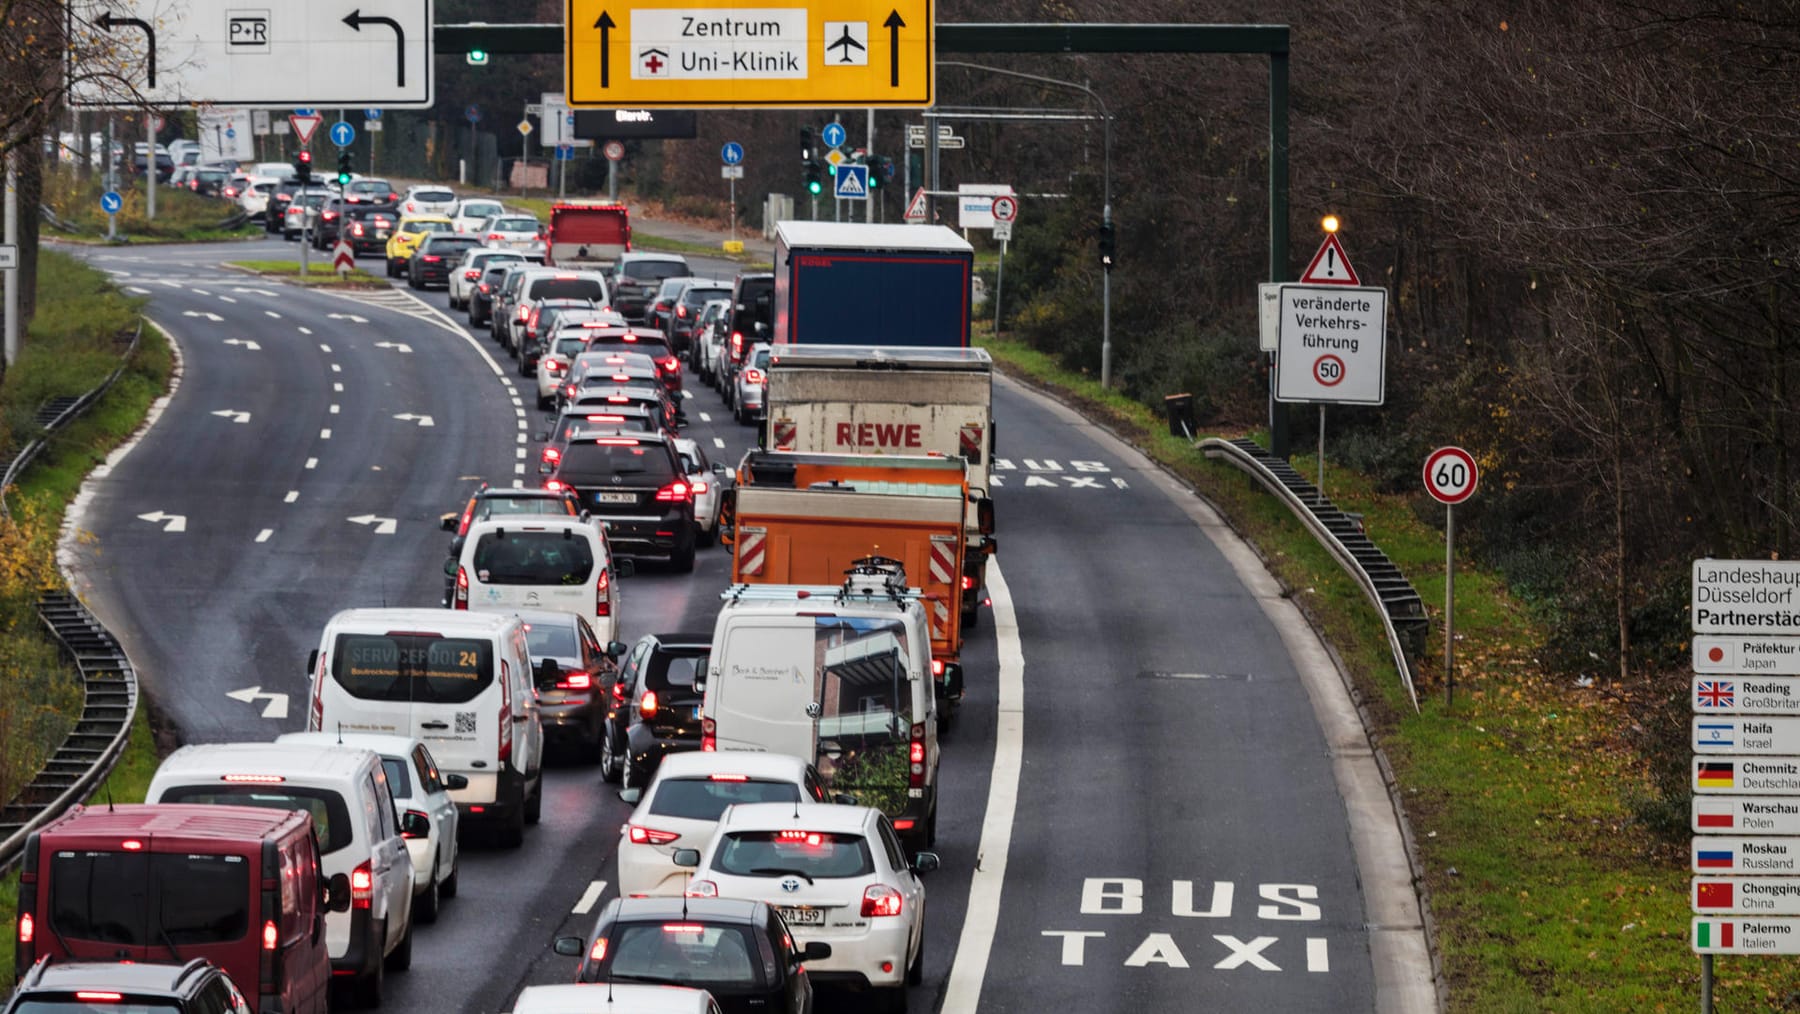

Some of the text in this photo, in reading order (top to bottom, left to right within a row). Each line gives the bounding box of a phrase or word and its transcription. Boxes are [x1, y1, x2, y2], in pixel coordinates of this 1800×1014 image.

[230, 22, 267, 41] P+R
[682, 17, 780, 36] Zentrum
[682, 52, 799, 71] Uni-Klinik
[1292, 296, 1370, 312] veränderte
[1295, 313, 1368, 330] Verkehrs-
[1302, 334, 1359, 353] führung
[1320, 362, 1339, 378] 50
[836, 422, 922, 447] REWE
[1436, 463, 1465, 487] 60
[1697, 586, 1792, 604] Düsseldorf
[1743, 643, 1796, 654] Präfektur
[1742, 658, 1776, 670] Japan
[1743, 682, 1790, 696] Reading
[1743, 723, 1773, 734] Haifa
[1743, 738, 1772, 749] Israel
[1743, 762, 1798, 774] Chemnitz
[1743, 803, 1799, 814] Warschau
[1743, 818, 1774, 828] Polen
[1743, 843, 1787, 854] Moskau
[1743, 858, 1794, 869] Russland
[1080, 878, 1321, 920] BUS
[1742, 898, 1775, 909] China
[800, 910, 820, 921] 159
[1743, 923, 1791, 934] Palermo
[1743, 938, 1776, 949] Italien
[1041, 931, 1329, 972] TAXI
